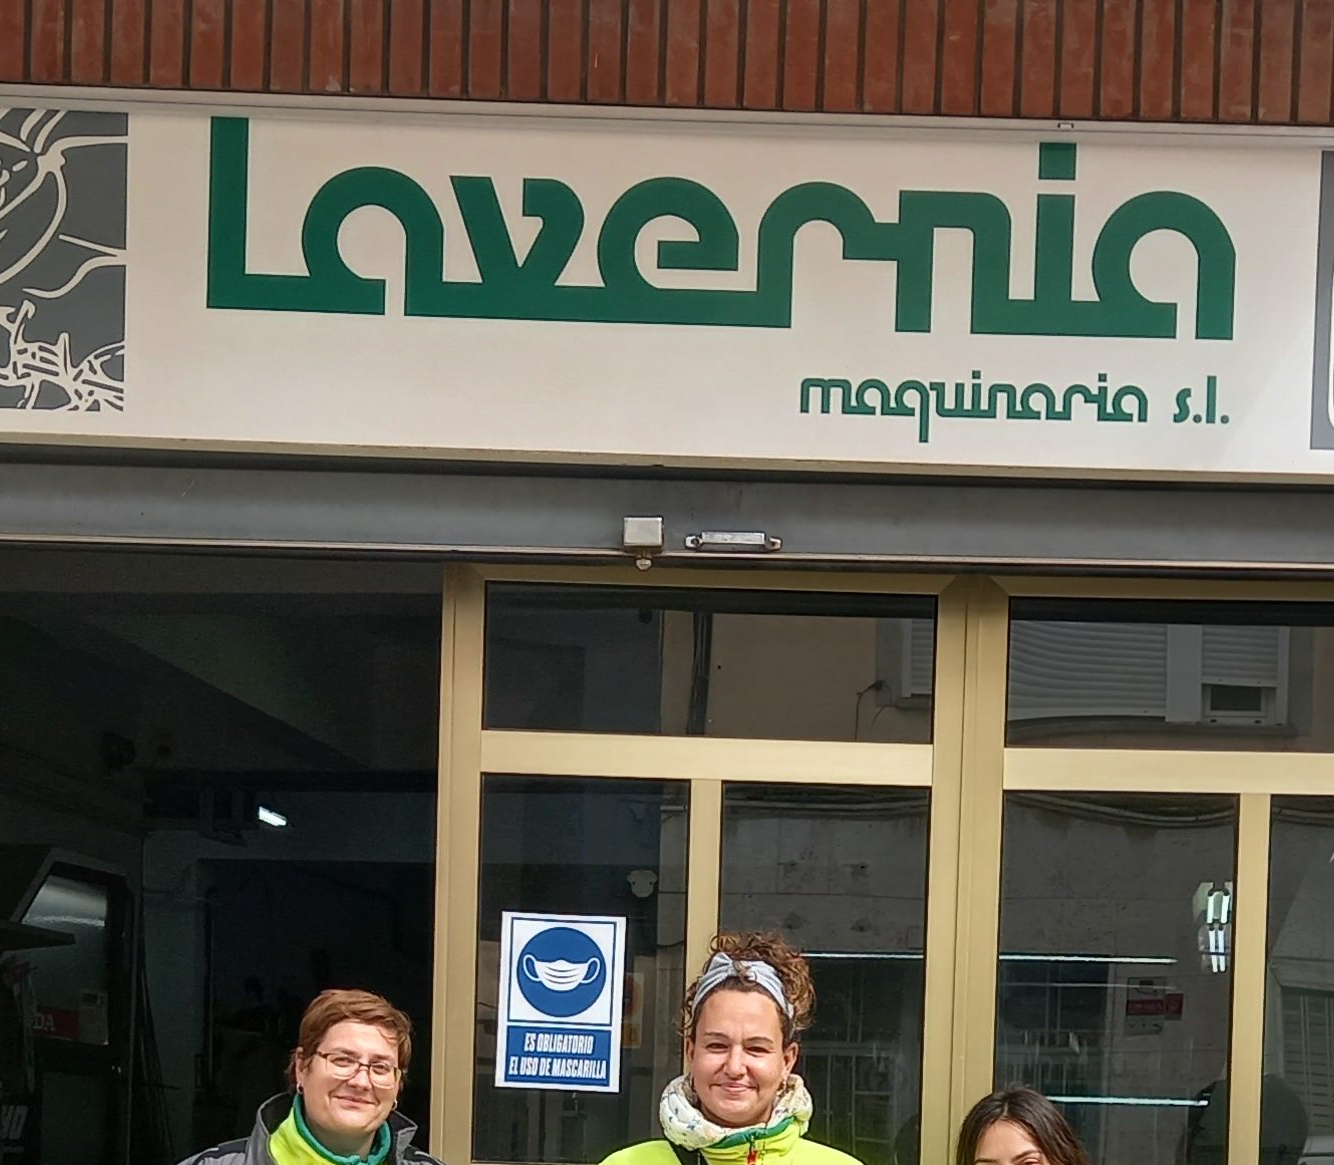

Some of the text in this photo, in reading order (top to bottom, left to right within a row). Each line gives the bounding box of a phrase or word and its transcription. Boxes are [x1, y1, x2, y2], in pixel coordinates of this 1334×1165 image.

[207, 116, 1236, 340] Lavernia
[800, 370, 1230, 443] maquinaria s.l.
[508, 1055, 607, 1079] EL USO DE MASCARILLA
[524, 1032, 594, 1054] ES OBLIGATORIO
